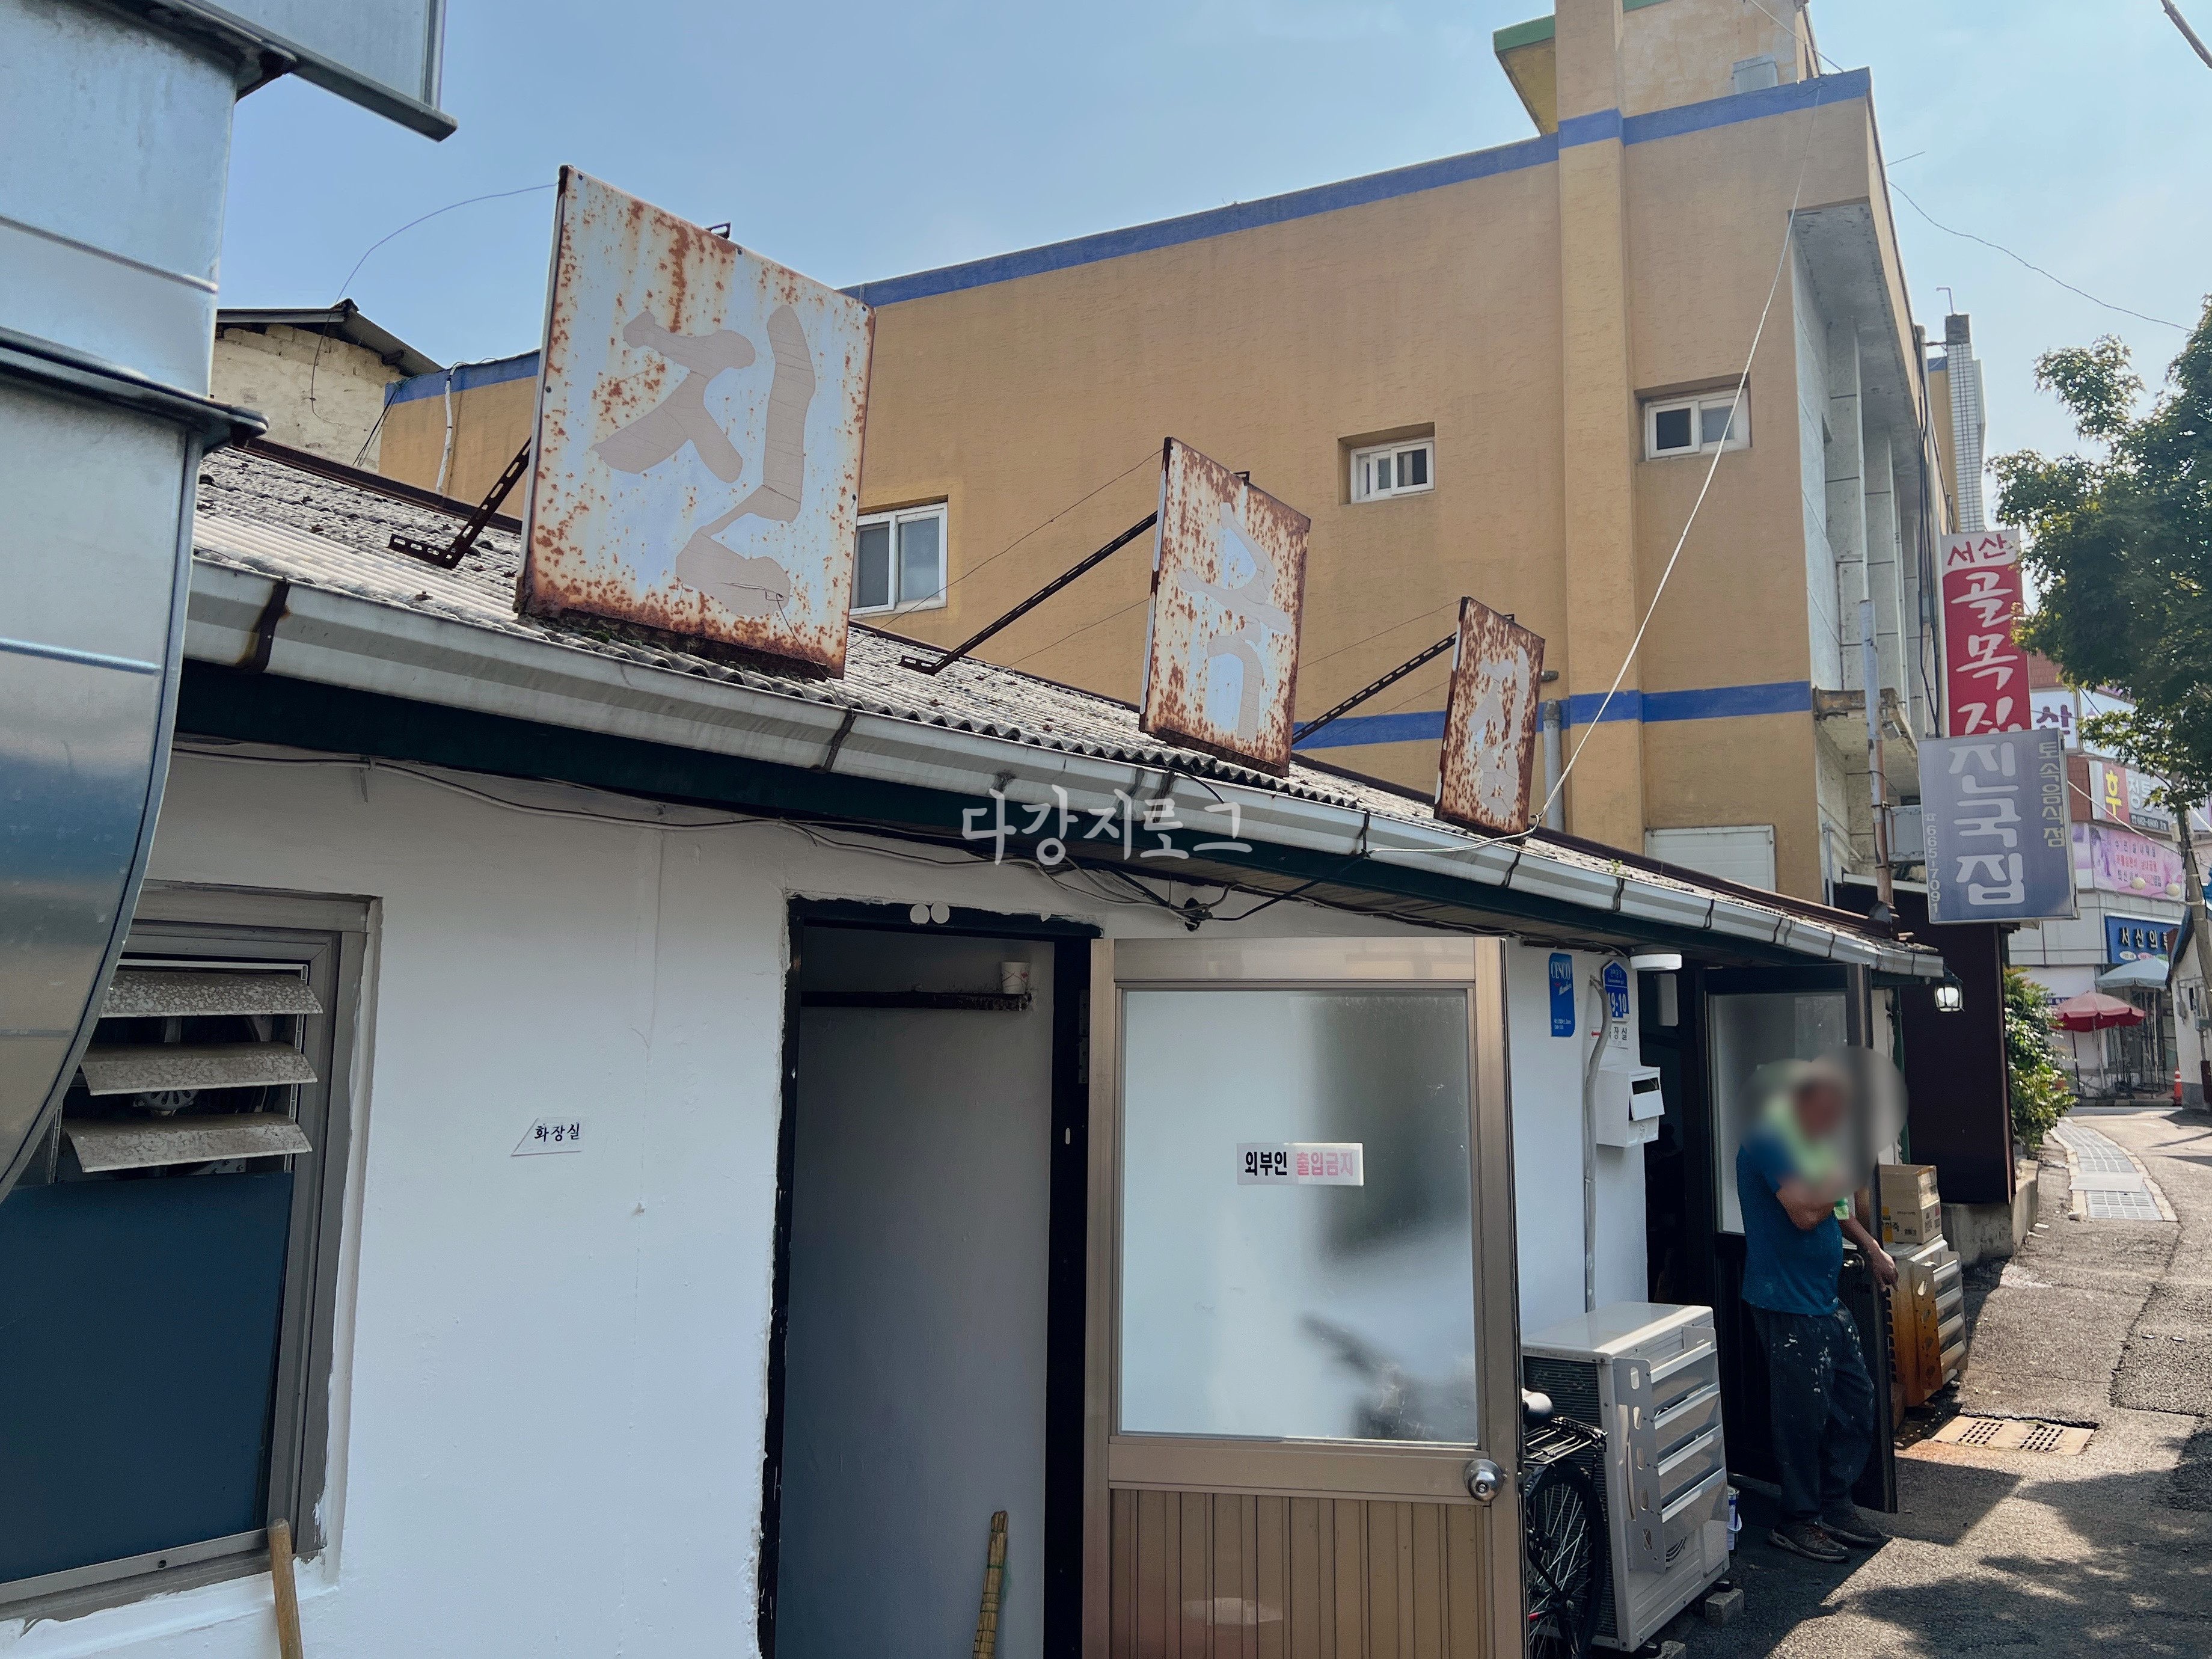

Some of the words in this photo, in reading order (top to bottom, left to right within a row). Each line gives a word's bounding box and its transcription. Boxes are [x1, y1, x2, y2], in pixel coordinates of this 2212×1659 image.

[1947, 533, 2008, 566] 서산
[2037, 741, 2065, 848] 토속음식점
[2104, 769, 2122, 817] 후
[1948, 741, 2025, 906] 진국집
[1925, 825, 1941, 914] 665-7091
[1609, 1026, 1628, 1041] 장실
[534, 1123, 580, 1142] 화장실
[1245, 1151, 1287, 1176] 외부인
[1296, 1151, 1353, 1176] 출입금지
